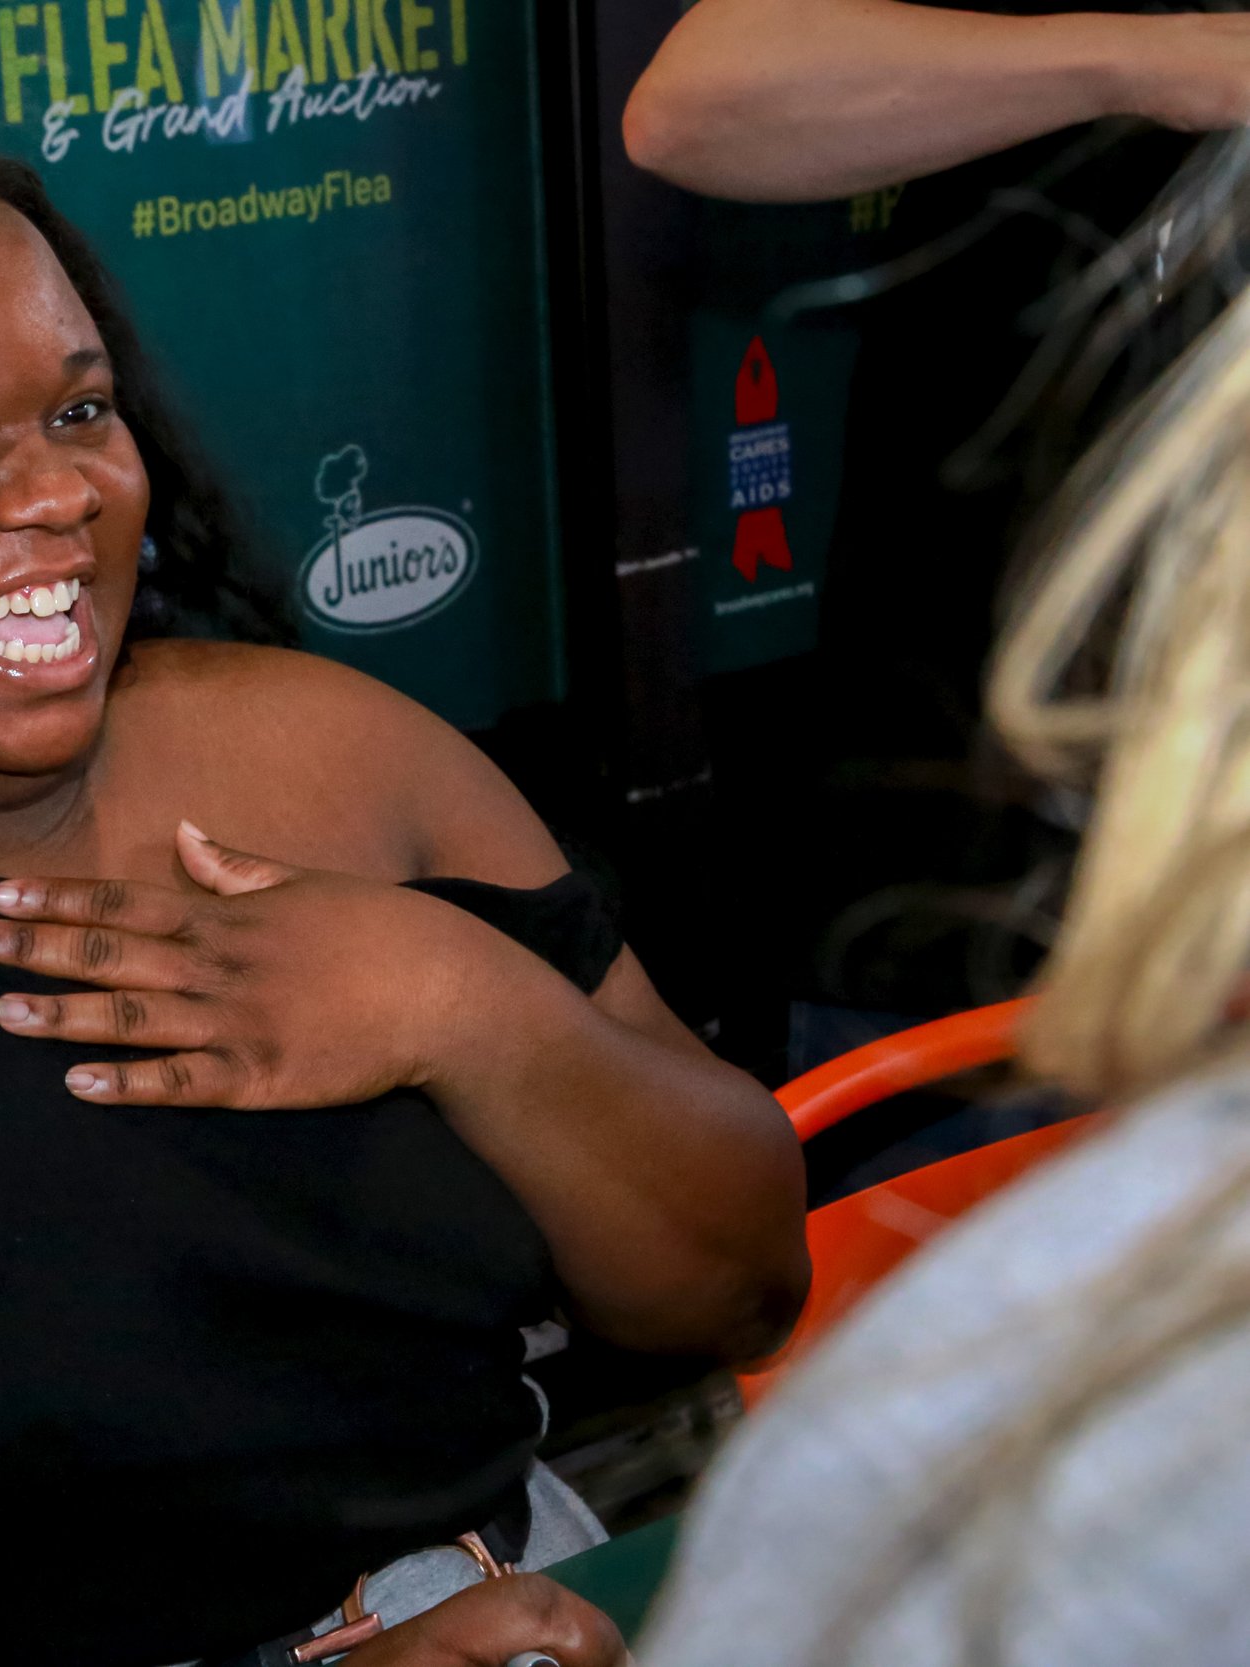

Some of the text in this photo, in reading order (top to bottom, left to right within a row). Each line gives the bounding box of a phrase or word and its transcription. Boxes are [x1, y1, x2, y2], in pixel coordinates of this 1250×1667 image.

[102, 69, 253, 153] Grand
[266, 63, 442, 133] Auction
[132, 170, 391, 238] #BroadwayFlea
[730, 480, 792, 509] AIDS
[323, 516, 459, 607] Junior's
